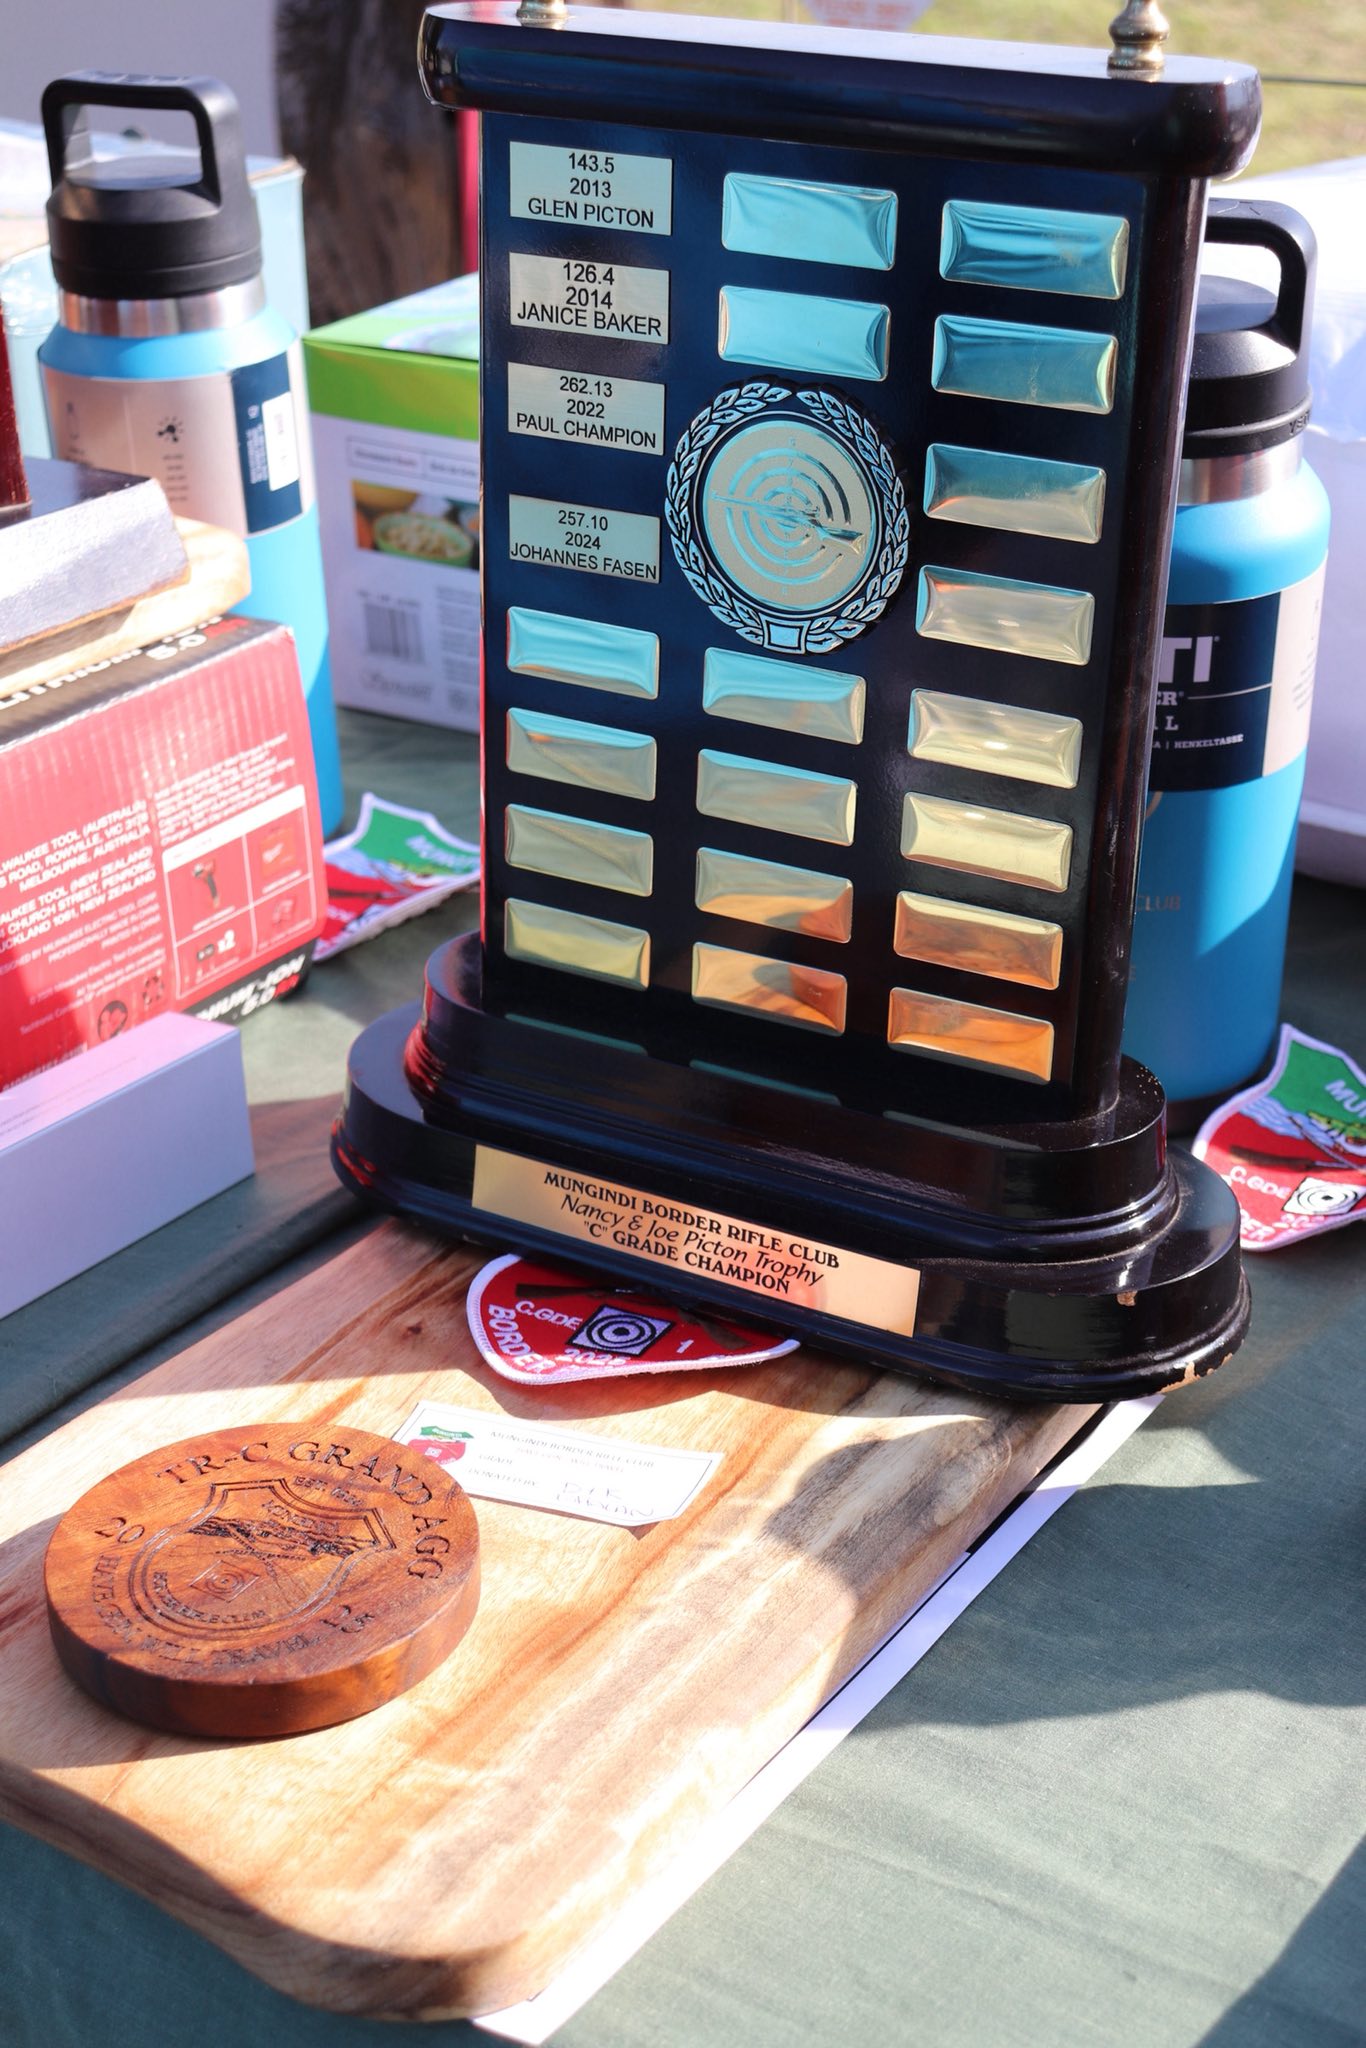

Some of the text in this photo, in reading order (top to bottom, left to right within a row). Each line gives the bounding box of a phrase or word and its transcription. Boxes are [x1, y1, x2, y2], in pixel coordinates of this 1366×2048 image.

[568, 152, 615, 174] 143.5
[570, 177, 612, 199] 2013
[528, 197, 654, 229] GLEN PICTON
[563, 261, 615, 286] 126.4
[565, 286, 613, 310] 2014
[517, 301, 662, 337] JANICE BAKER
[559, 375, 613, 398] 262.13
[566, 398, 605, 419] 2022
[516, 412, 656, 449] PAUL CHAMPION
[557, 509, 609, 531] 257.10
[564, 531, 602, 551] 2024
[510, 542, 657, 580] JOHANNES FASEN
[1174, 733, 1244, 749] HENKELTASSE
[0, 842, 50, 874] WAUKEE
[51, 829, 81, 850] TOOL
[93, 823, 151, 860] AUSTRALIA
[38, 885, 69, 906] TOOL
[80, 893, 106, 914] NEW
[107, 869, 157, 902] ZEALAND
[7, 902, 57, 935] CHURCH
[544, 1171, 840, 1269] MUNGINDI BORDER RIFLE CLUB
[560, 1193, 825, 1287] Nancy & Joe Picton Trophy
[583, 1220, 791, 1294] "C" GRADE CHAMPION
[515, 1300, 583, 1331] C.GDE
[488, 1304, 557, 1374] BORDER
[154, 1441, 451, 1579] TR-C GRAND AGG
[94, 1516, 146, 1544] 20
